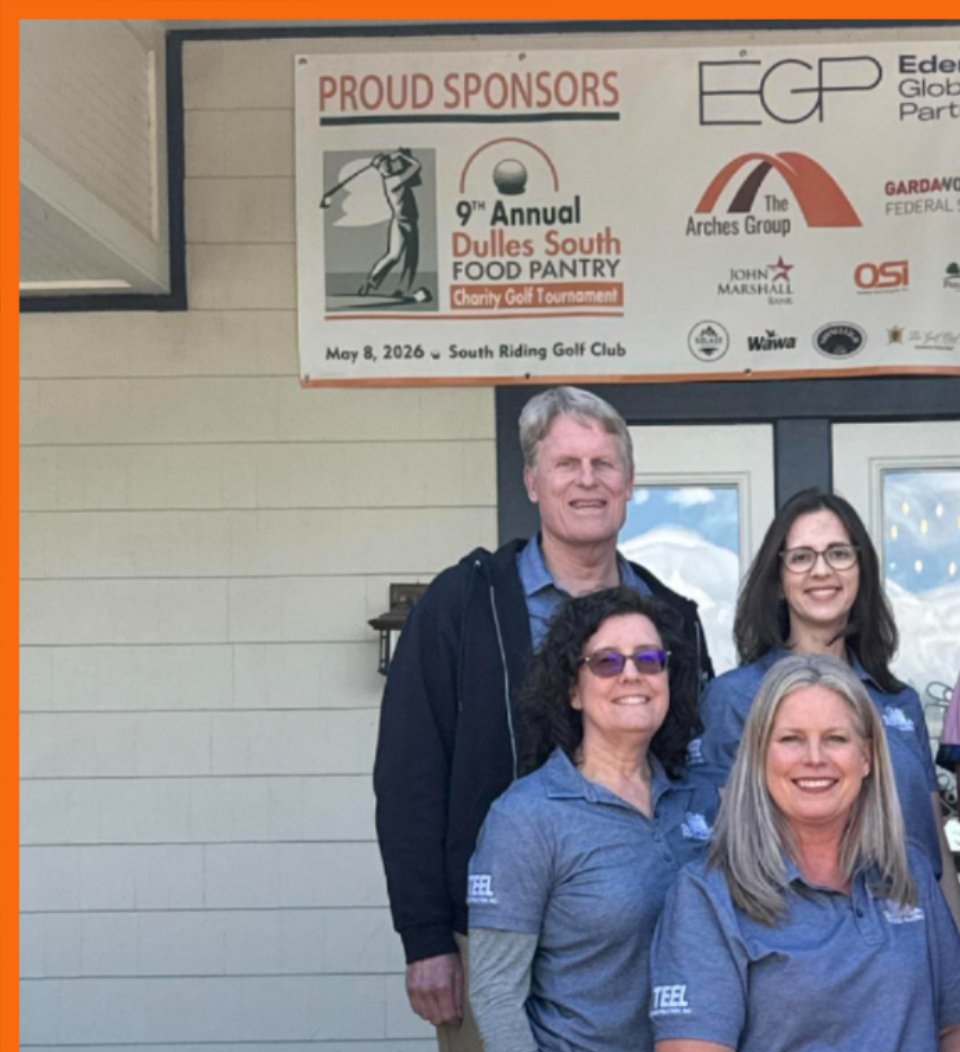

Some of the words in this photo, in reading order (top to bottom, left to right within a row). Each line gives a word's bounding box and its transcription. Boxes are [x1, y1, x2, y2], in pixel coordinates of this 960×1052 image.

[318, 73, 434, 112] PROUD
[443, 71, 620, 110] SPONSORS
[698, 56, 883, 126] EGP
[456, 200, 486, 227] 9TH
[490, 195, 581, 226] Annual
[764, 194, 790, 213] The
[885, 200, 952, 217] FEDERAL
[685, 215, 740, 237] Arches
[744, 215, 791, 237] Group
[452, 230, 534, 258] Dulles
[544, 227, 622, 256] South
[453, 260, 522, 281] FOOD
[529, 259, 620, 280] PANTRY
[729, 268, 769, 281] JOHN
[453, 289, 502, 309] Charity
[505, 287, 533, 305] Golf
[537, 287, 619, 304] Tournament
[717, 282, 794, 296] MARSHALL
[449, 345, 494, 360] South
[499, 344, 547, 360] Riding
[553, 343, 586, 358] Golf
[590, 342, 626, 358] Club
[748, 333, 797, 351] Wawa
[326, 347, 359, 364] May
[363, 346, 378, 362] 8,
[383, 345, 425, 360] 2026
